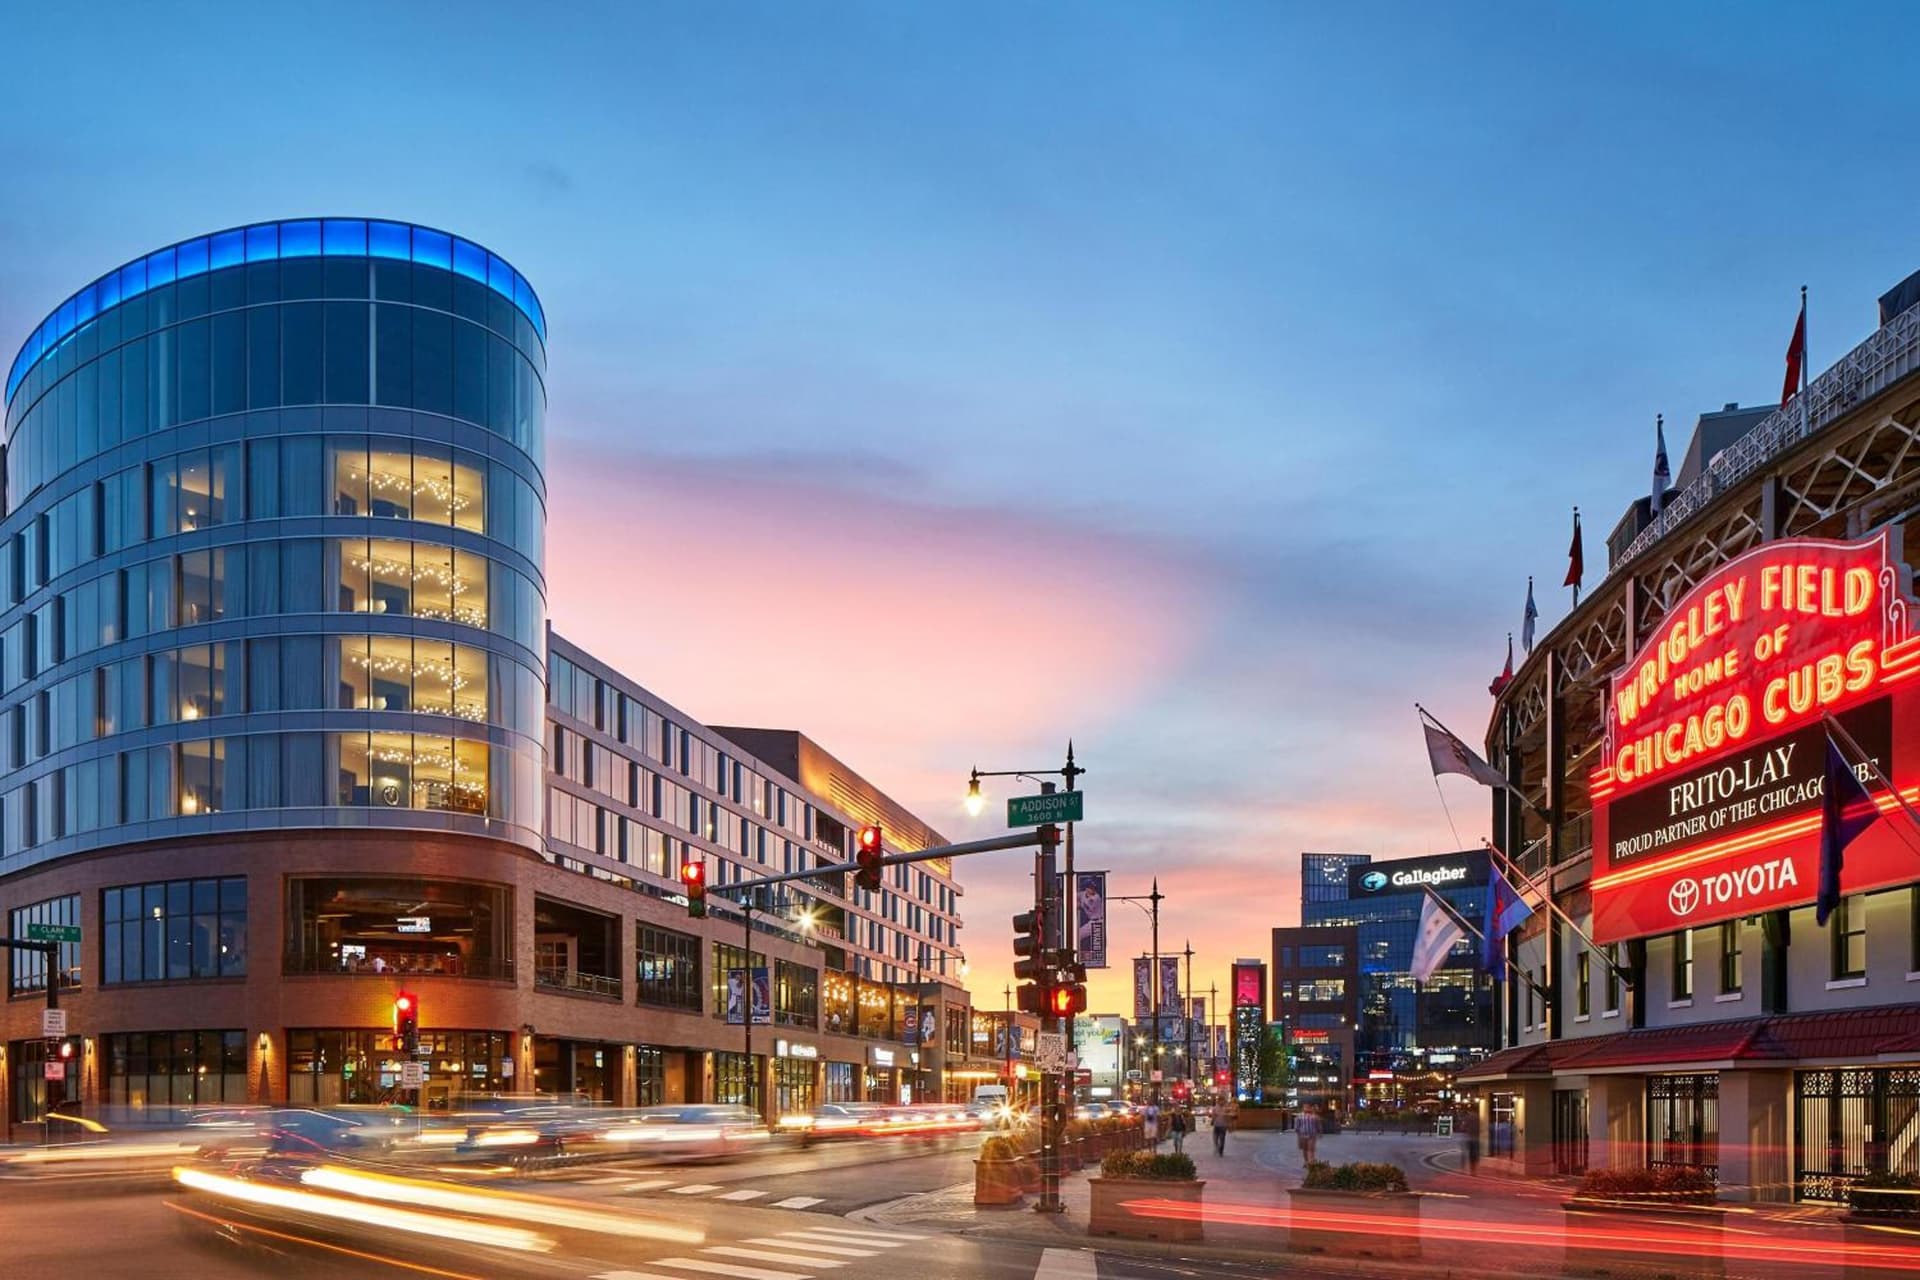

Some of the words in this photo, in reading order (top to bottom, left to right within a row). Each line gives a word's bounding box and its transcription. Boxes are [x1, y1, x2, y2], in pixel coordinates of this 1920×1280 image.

[1617, 575, 1747, 726] WRIGLEY
[1760, 564, 1875, 616] FIELD
[1674, 648, 1739, 701] HOME
[1754, 623, 1790, 662] OF
[1616, 694, 1751, 783] CHICAGO
[1762, 639, 1876, 724] CUBS
[1021, 796, 1067, 814] ADDISON
[1669, 743, 1796, 817] FRITO-LAY
[1615, 833, 1653, 859] PROUD
[1655, 815, 1708, 847] PARTNER
[1710, 808, 1728, 830] OF
[1730, 796, 1757, 824] THE
[1392, 867, 1467, 886] Gallagher
[1703, 857, 1798, 905] TOYOTA
